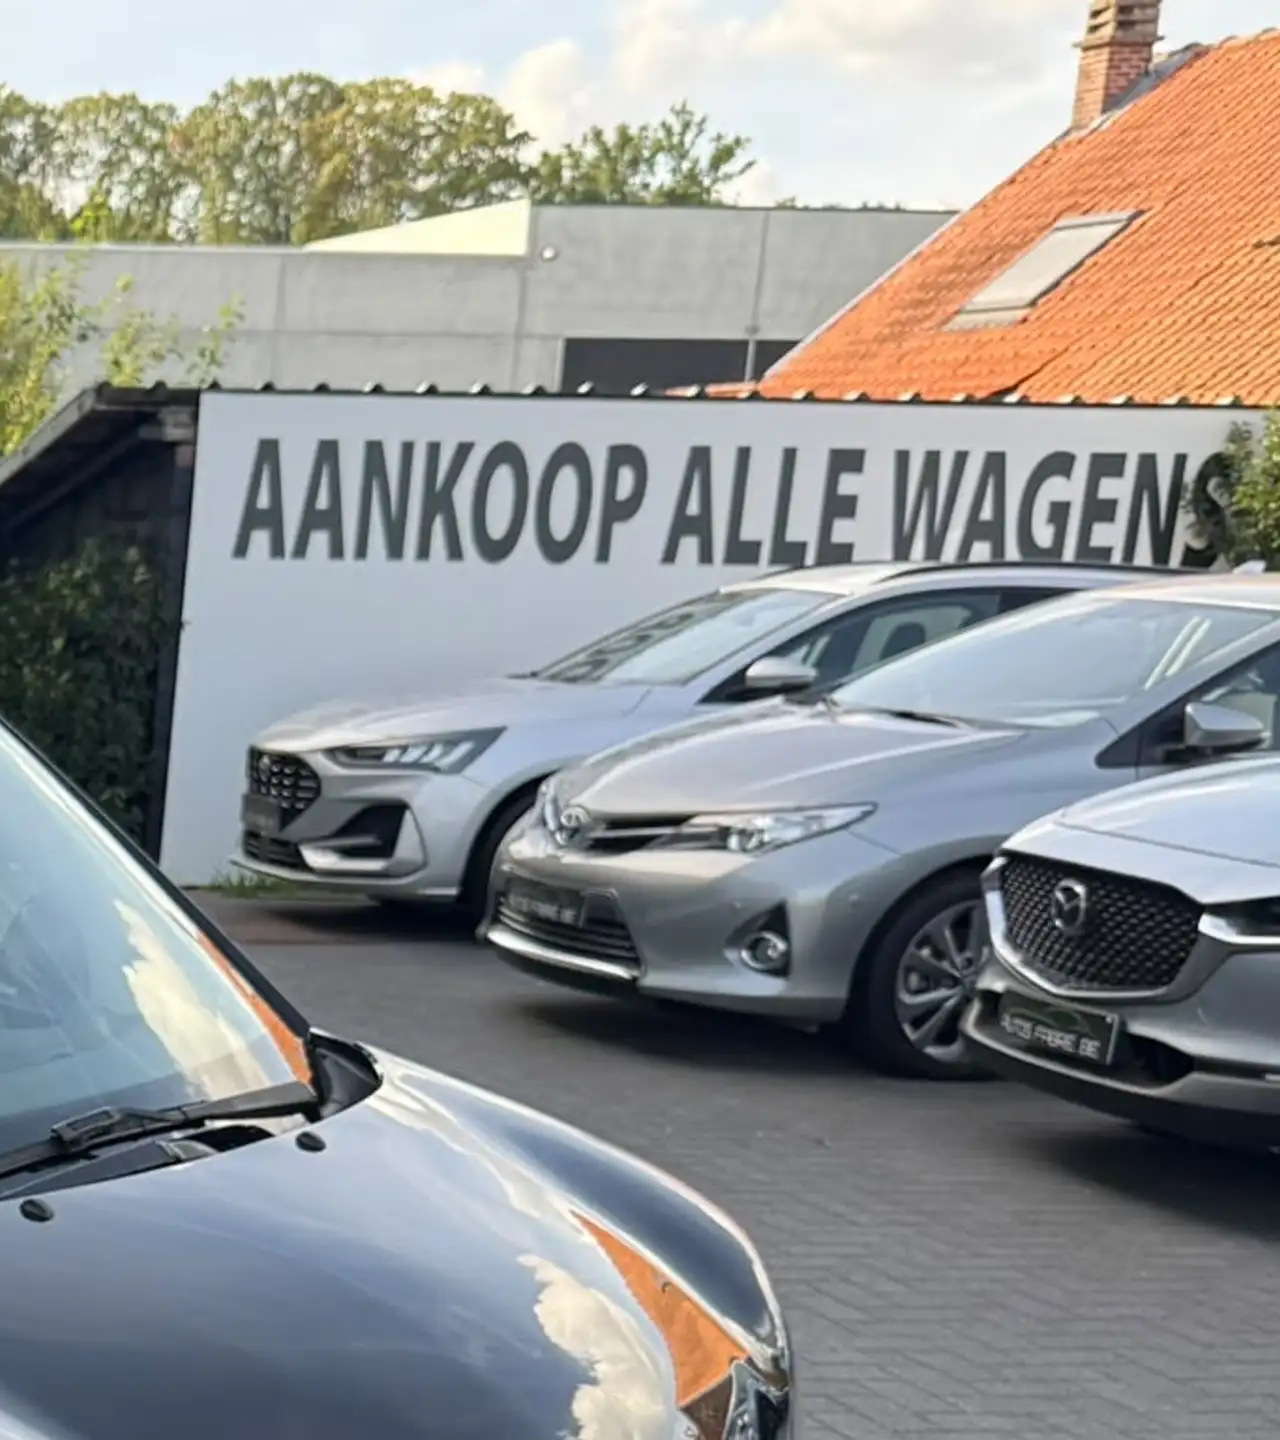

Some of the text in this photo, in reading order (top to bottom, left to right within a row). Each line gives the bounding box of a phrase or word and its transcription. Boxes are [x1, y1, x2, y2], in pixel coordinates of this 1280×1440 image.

[233, 437, 1236, 569] AANKOOP ALLE WAGENS
